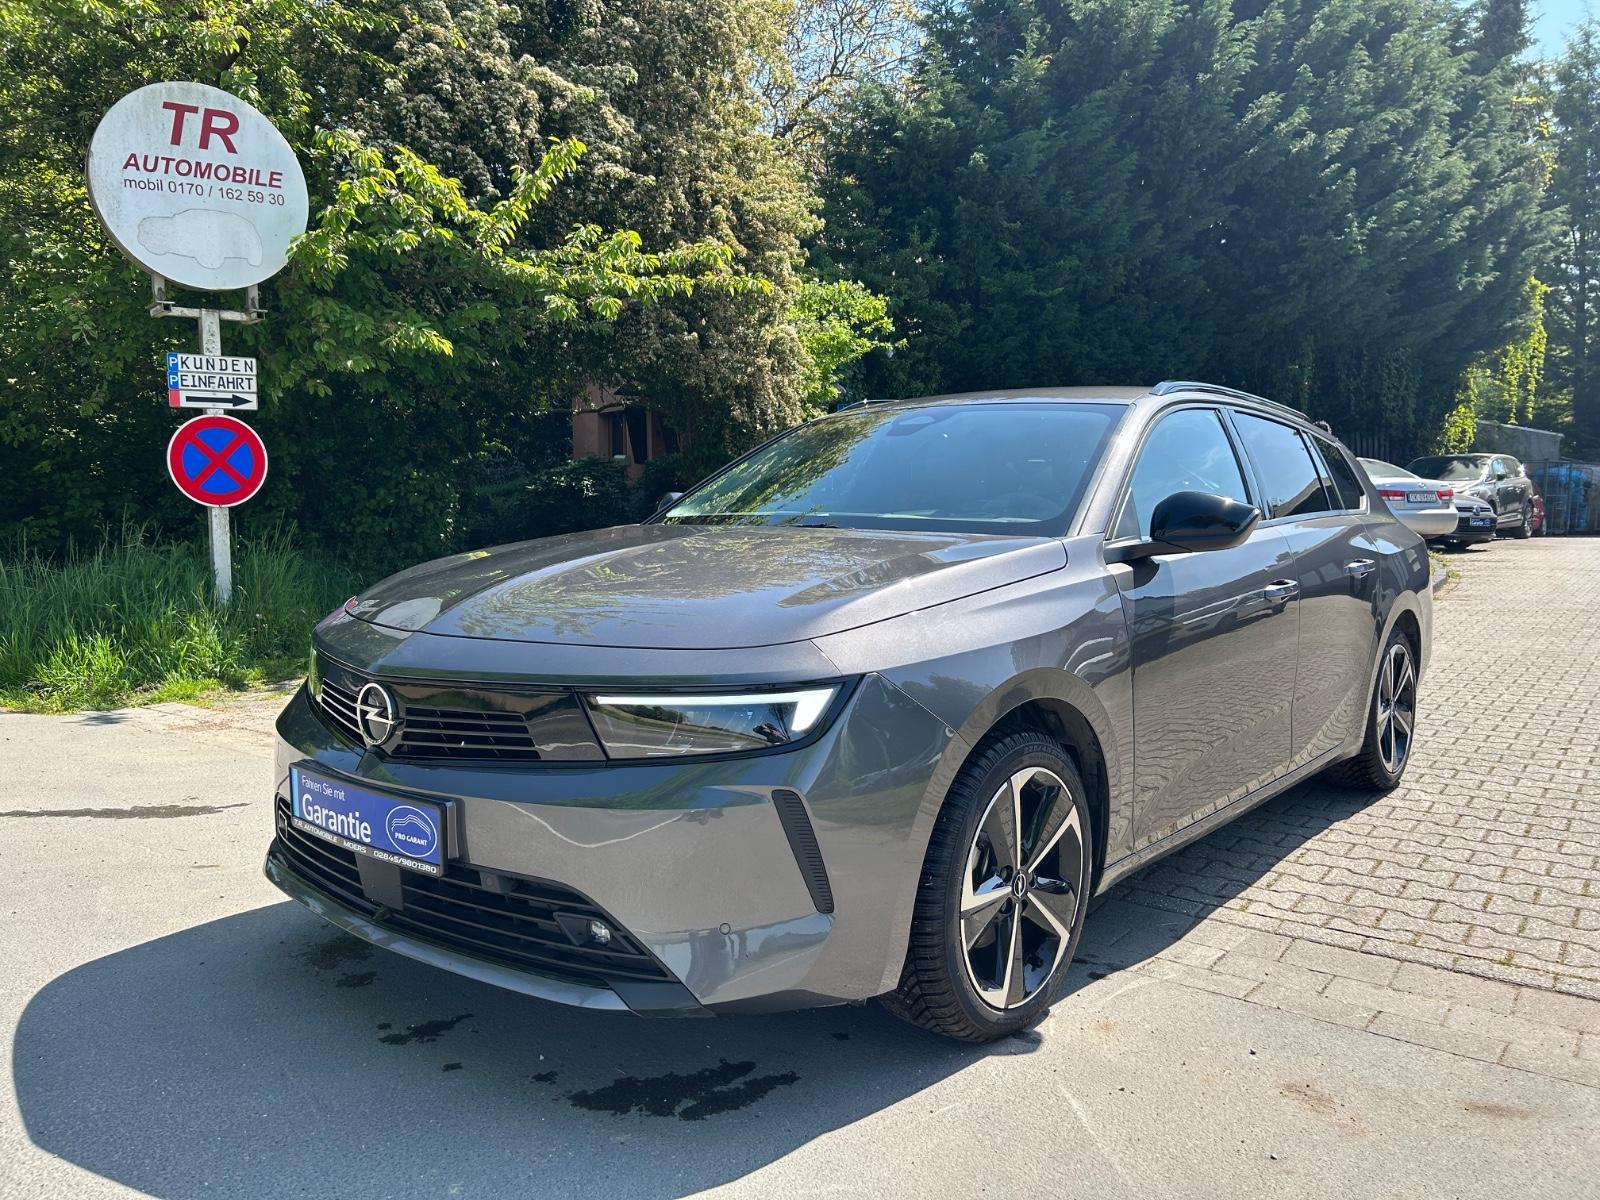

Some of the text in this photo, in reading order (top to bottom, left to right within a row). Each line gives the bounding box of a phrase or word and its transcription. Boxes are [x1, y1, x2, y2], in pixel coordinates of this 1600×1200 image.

[162, 101, 240, 154] TR
[122, 152, 283, 189] AUTOMOBILE
[123, 177, 285, 206] mobil 0170 / 162 59 30
[169, 356, 254, 373] P KUNDEN
[170, 374, 254, 390] P EINFAHRT
[302, 775, 345, 801] Fahren Sie mit
[302, 793, 371, 843] Garantie
[304, 824, 338, 843] AUTOMOBILE
[343, 840, 367, 853] MOERS
[394, 832, 428, 846] PRO GARANT
